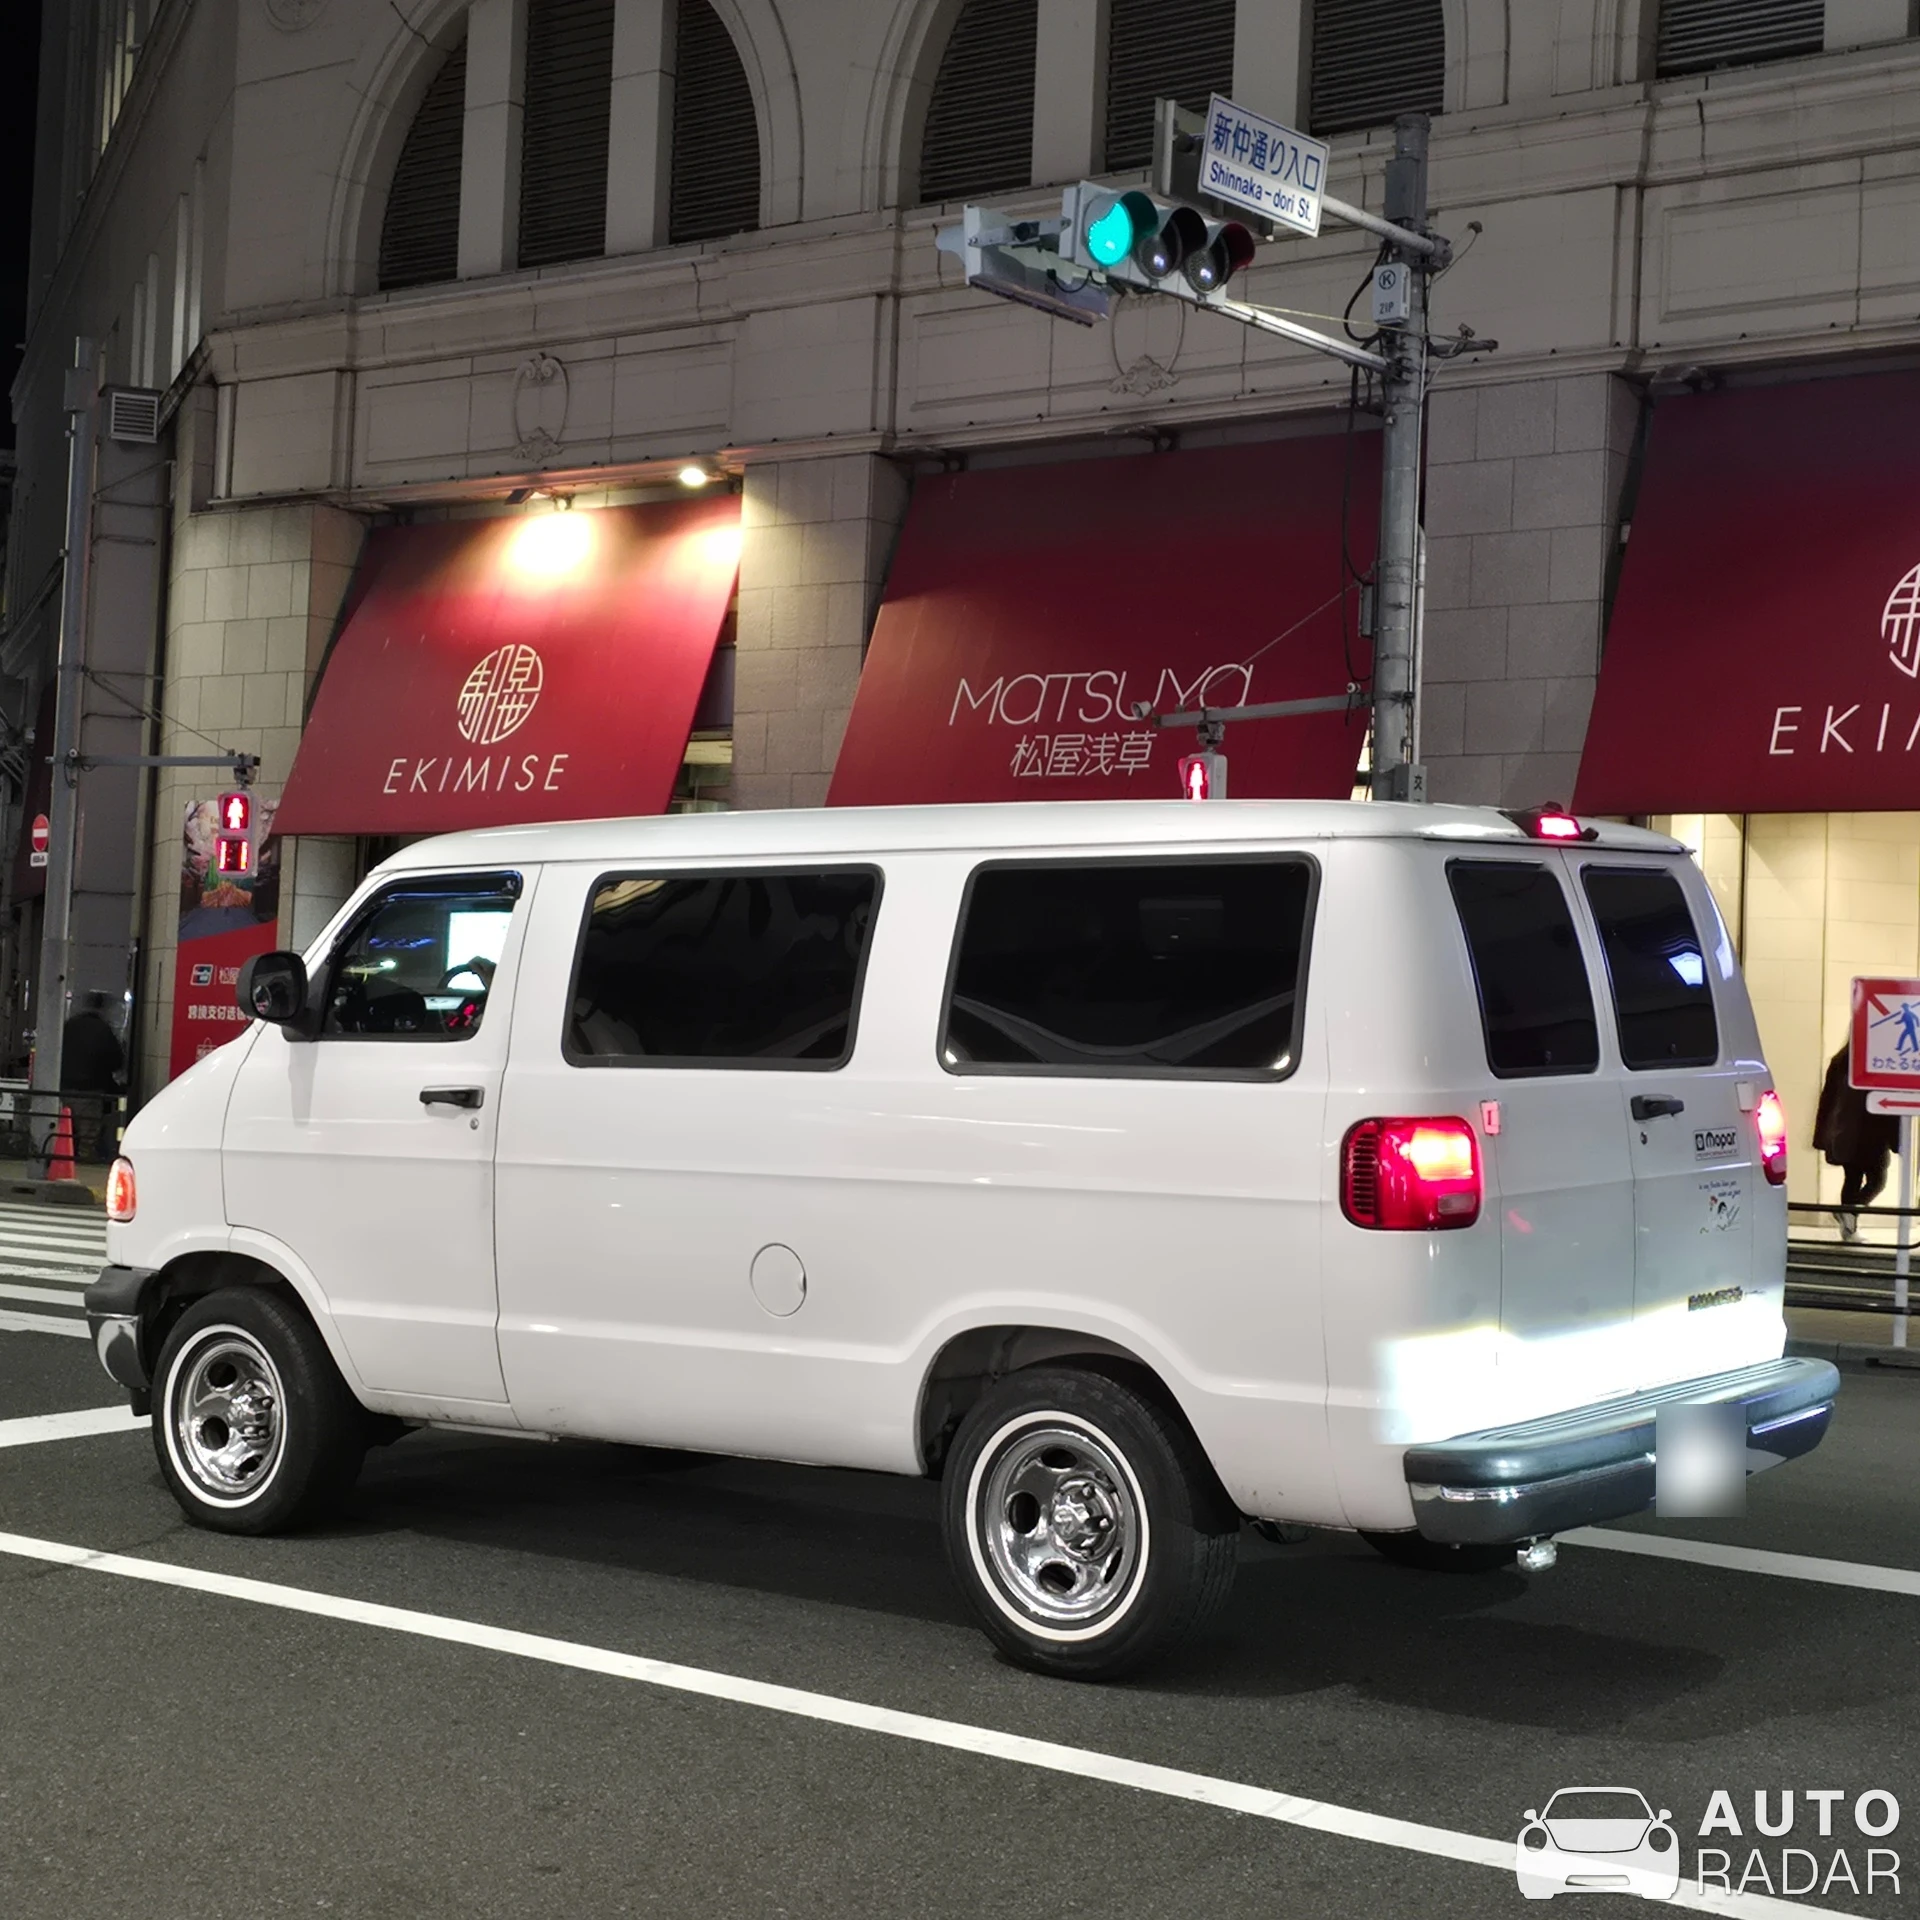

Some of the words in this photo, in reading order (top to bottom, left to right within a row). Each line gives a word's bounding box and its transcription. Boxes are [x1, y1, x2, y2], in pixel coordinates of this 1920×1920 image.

[1211, 111, 1320, 191] 新仲通り入口
[1297, 198, 1311, 222] St.
[383, 754, 569, 793] EKIMISE
[1010, 731, 1157, 777] 松屋浅草
